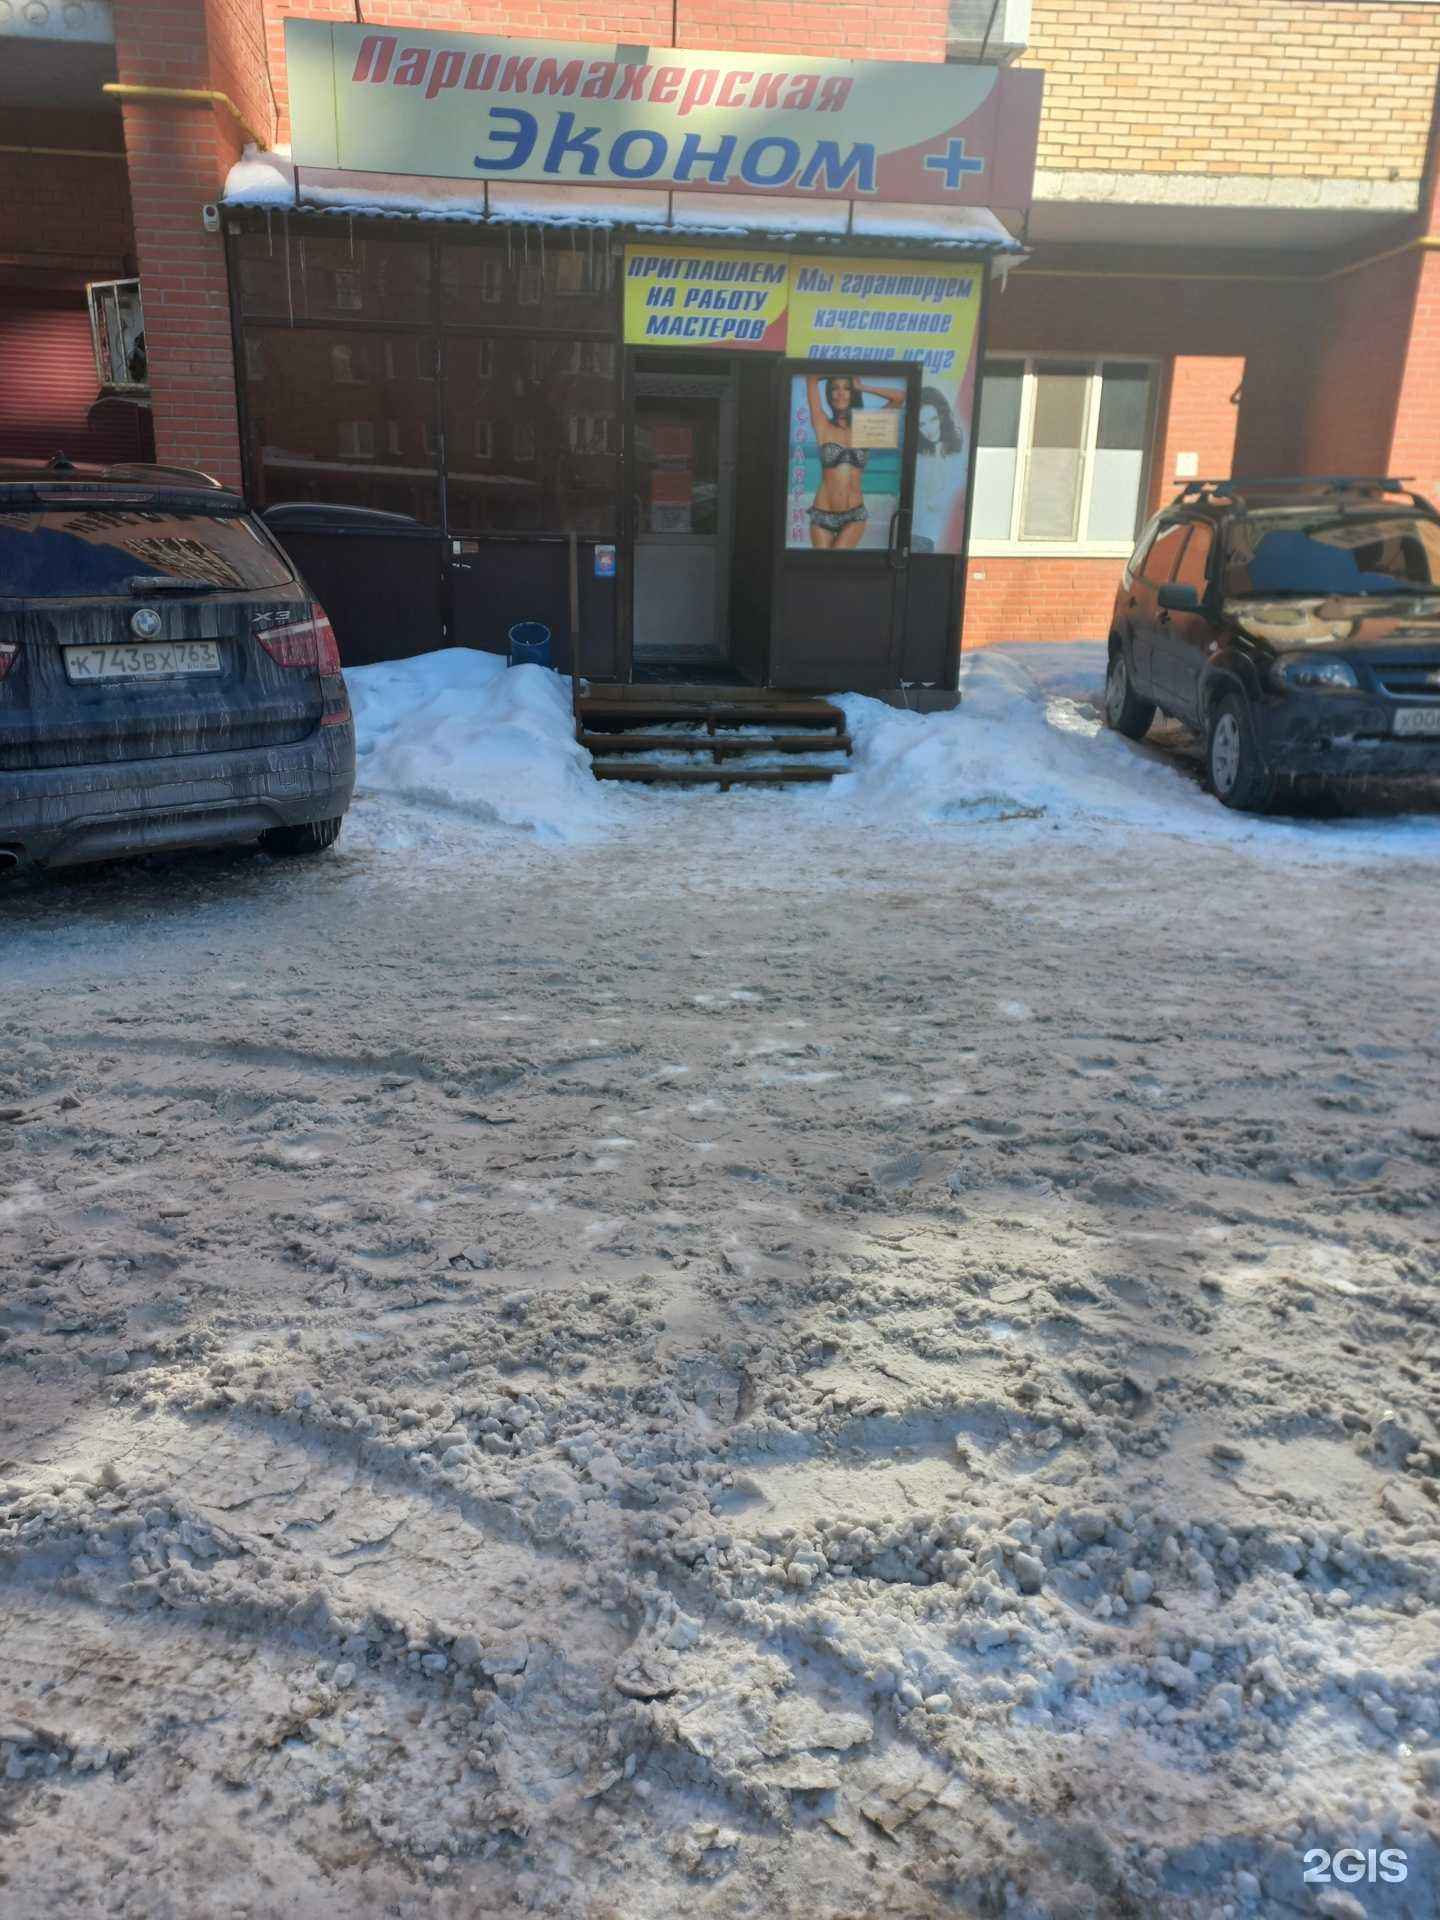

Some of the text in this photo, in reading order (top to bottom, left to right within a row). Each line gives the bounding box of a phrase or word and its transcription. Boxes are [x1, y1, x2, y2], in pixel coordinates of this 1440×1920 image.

[352, 35, 854, 116] Парикмахерская
[627, 256, 787, 284] ПРИГЛАШАЕМ
[796, 267, 974, 304] Мы гарантируем
[646, 286, 768, 312] НА РАБОТУ
[645, 314, 767, 340] МАСТЕРОВ
[813, 308, 953, 333] качественное
[252, 610, 291, 623] X3
